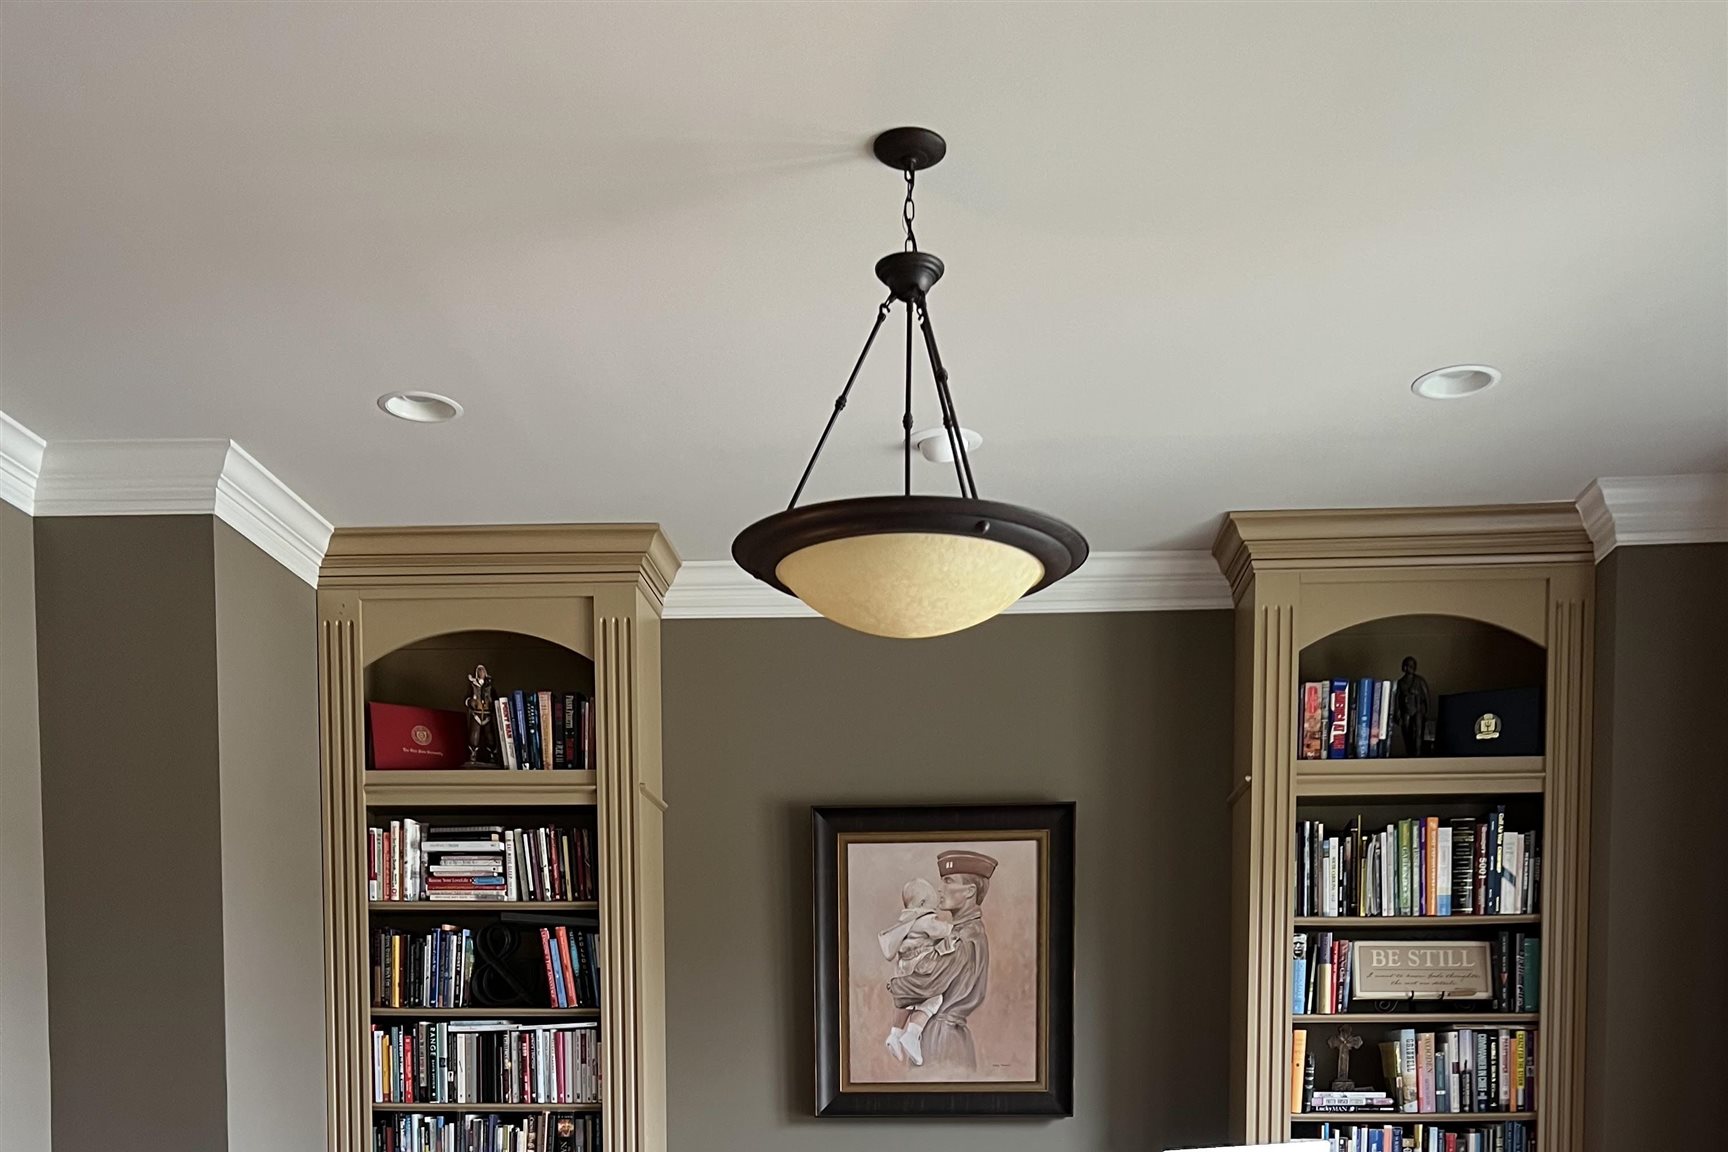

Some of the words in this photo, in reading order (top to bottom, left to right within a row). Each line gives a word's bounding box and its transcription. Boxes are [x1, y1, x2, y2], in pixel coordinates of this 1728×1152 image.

[506, 723, 514, 739] MAN
[578, 931, 587, 963] APOLLO
[1371, 949, 1401, 967] BE
[1407, 948, 1477, 968] STILL
[429, 1026, 438, 1058] RANGE
[1424, 1037, 1433, 1073] WOODEN
